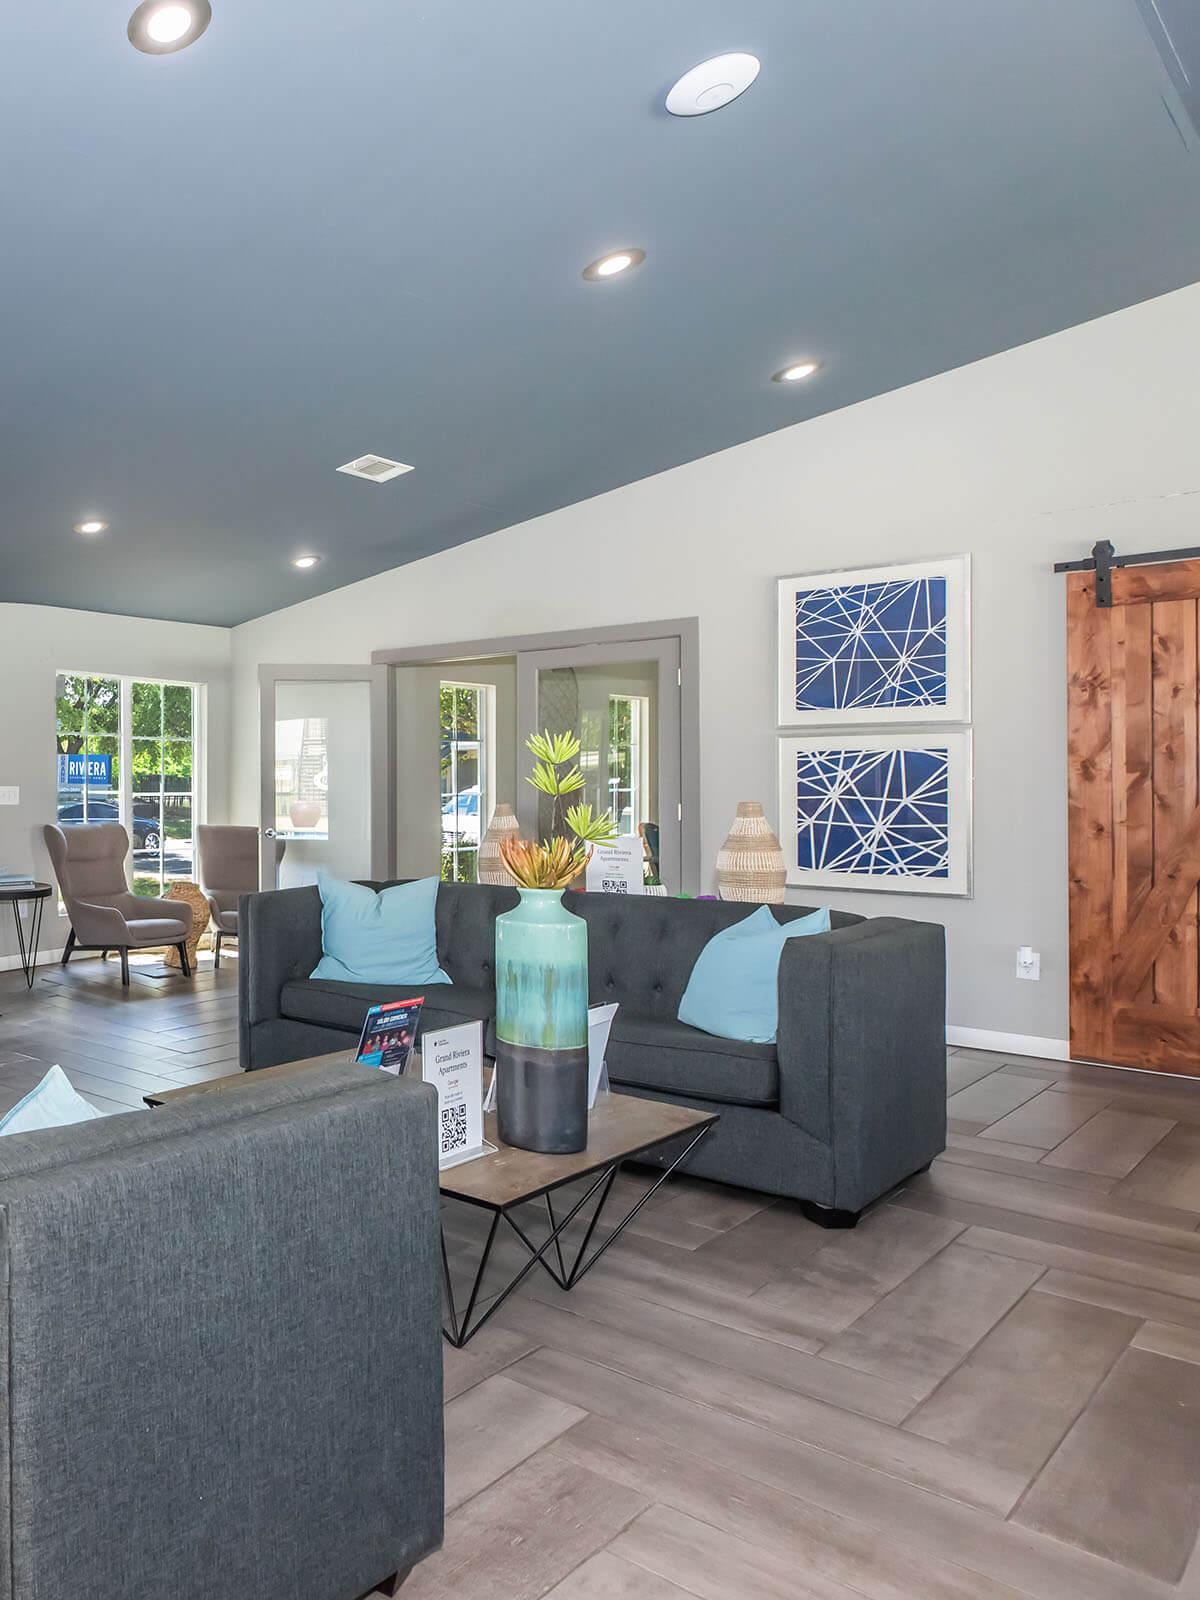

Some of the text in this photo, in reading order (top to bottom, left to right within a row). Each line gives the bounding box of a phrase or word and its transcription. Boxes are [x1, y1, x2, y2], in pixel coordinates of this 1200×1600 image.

[69, 761, 106, 776] RIVERA
[435, 1049, 471, 1064] Grand Riviera
[439, 1062, 468, 1076] Apartments
